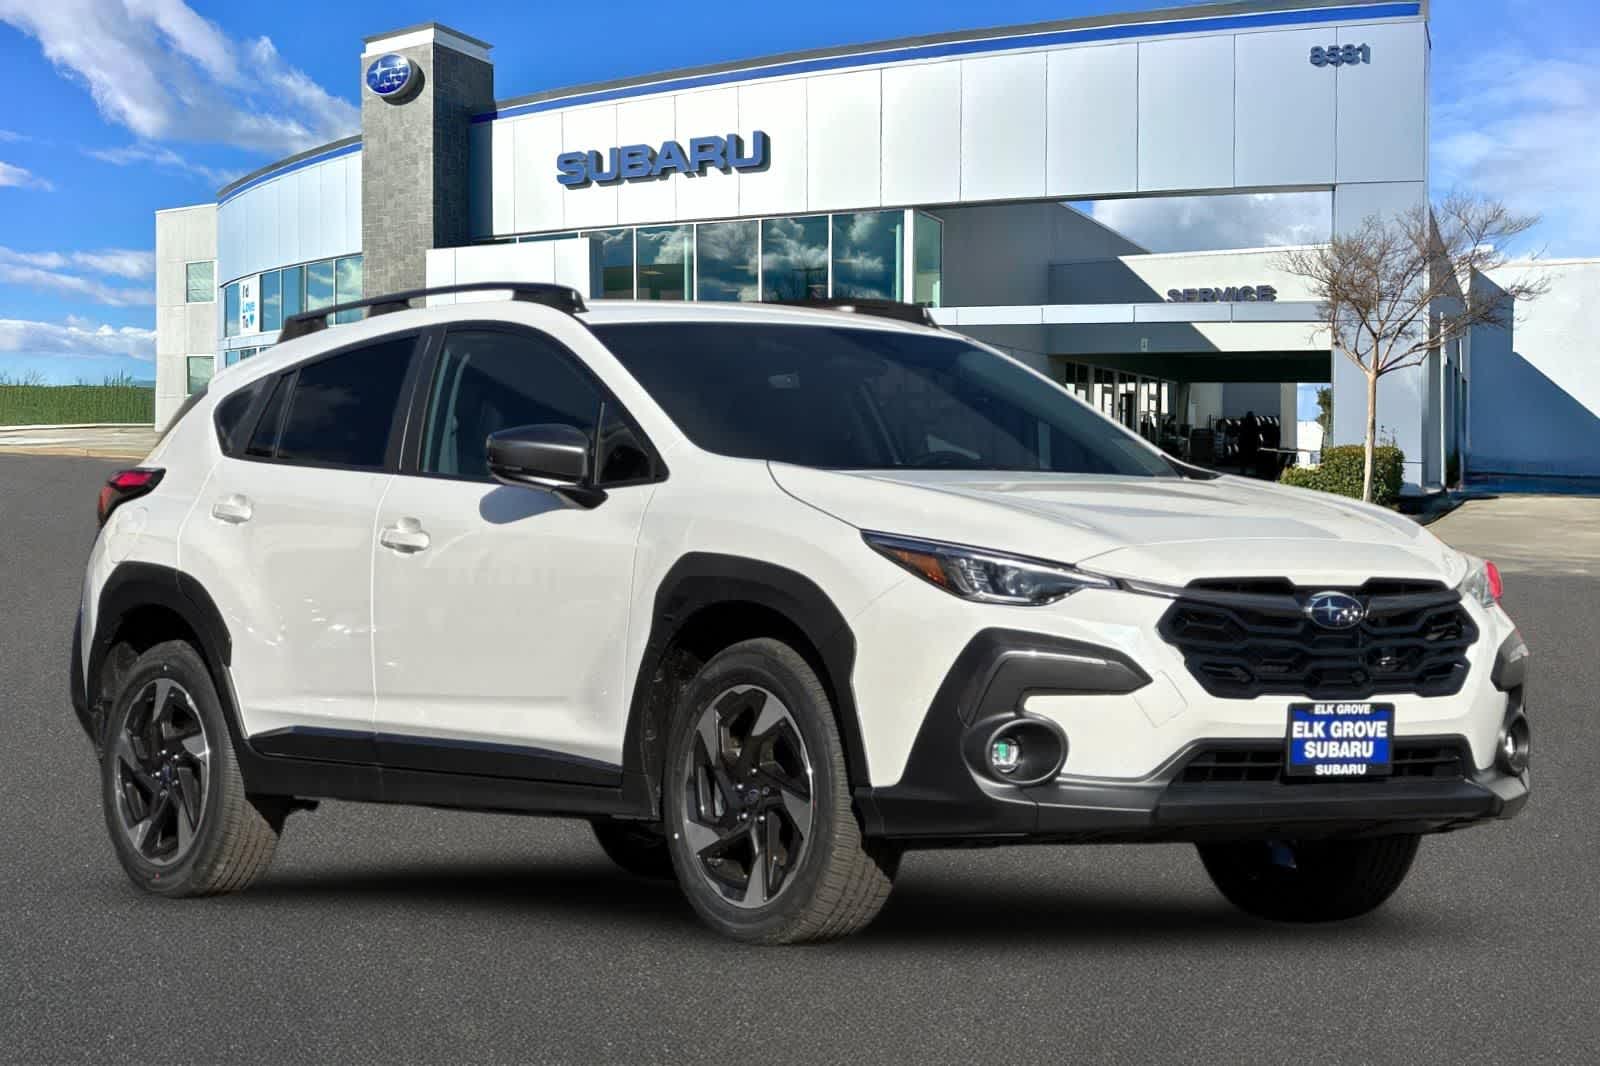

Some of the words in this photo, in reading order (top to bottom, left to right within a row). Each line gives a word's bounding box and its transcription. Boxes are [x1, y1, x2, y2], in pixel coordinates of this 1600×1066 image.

[557, 130, 770, 189] SUBARU
[1167, 285, 1277, 303] SERVICE
[1314, 704, 1334, 714] ELK
[1336, 704, 1371, 714] GROVE
[1292, 721, 1326, 738] ELK
[1330, 721, 1387, 738] GROVE
[1304, 741, 1374, 758] SUBARU
[1315, 764, 1366, 775] SUBARU
